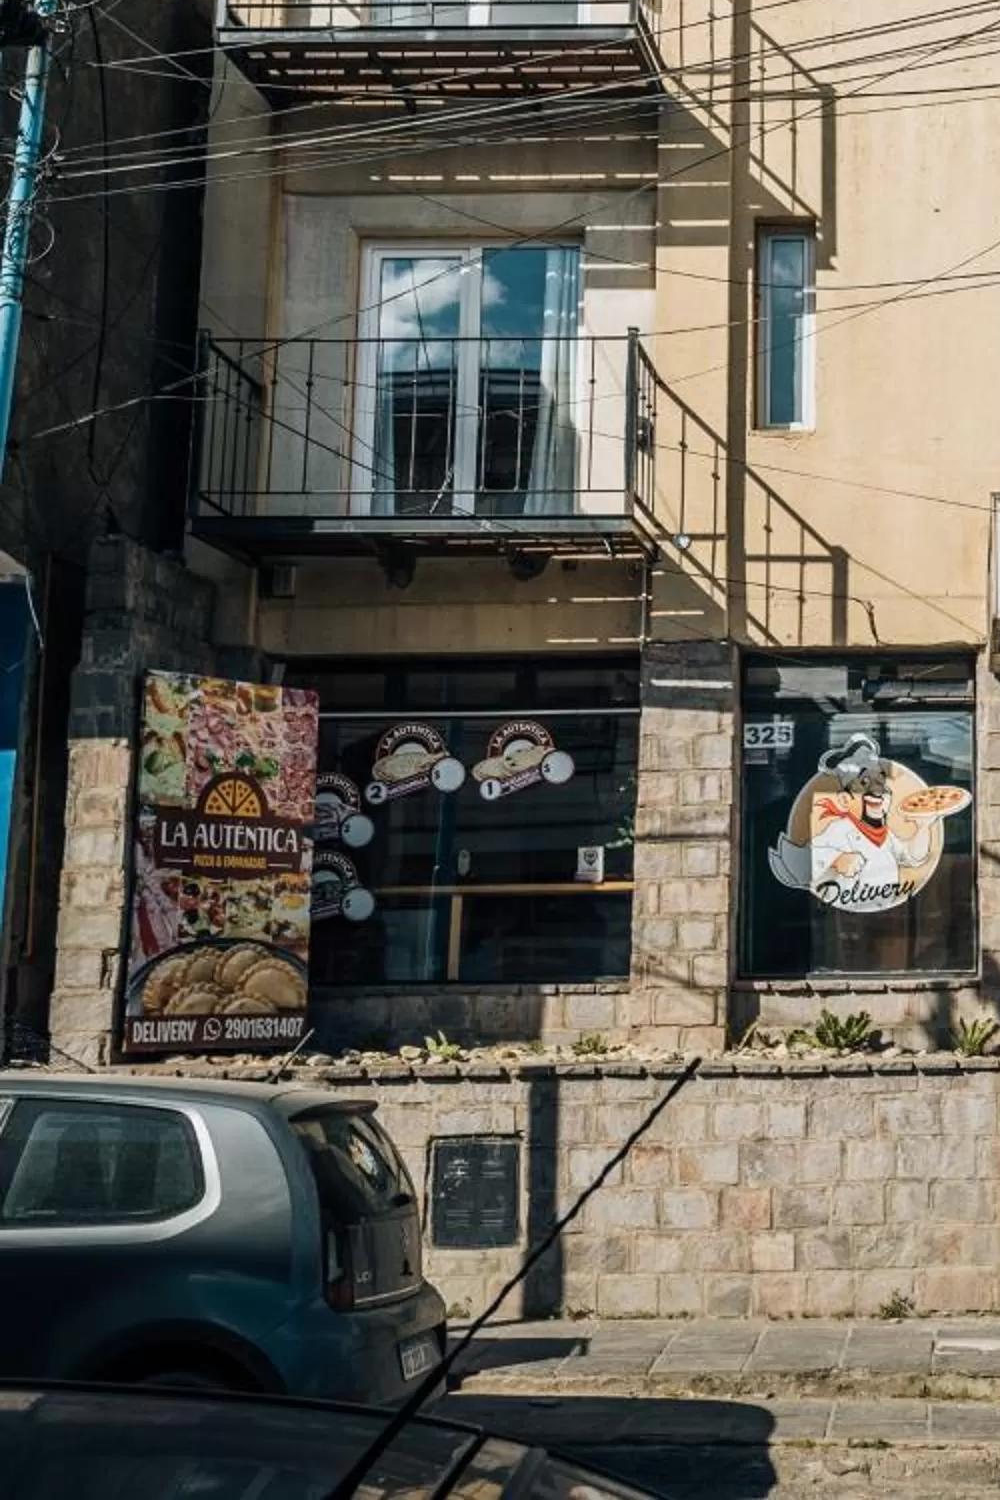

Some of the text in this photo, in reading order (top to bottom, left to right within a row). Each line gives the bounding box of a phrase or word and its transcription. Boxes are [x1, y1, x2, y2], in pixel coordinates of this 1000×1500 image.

[746, 725, 791, 745] 325
[370, 785, 382, 799] 2
[160, 820, 188, 848] LA
[193, 820, 299, 853] AUTÉNTICA
[815, 879, 916, 908] Delivery
[132, 1018, 197, 1044] DELIVERY
